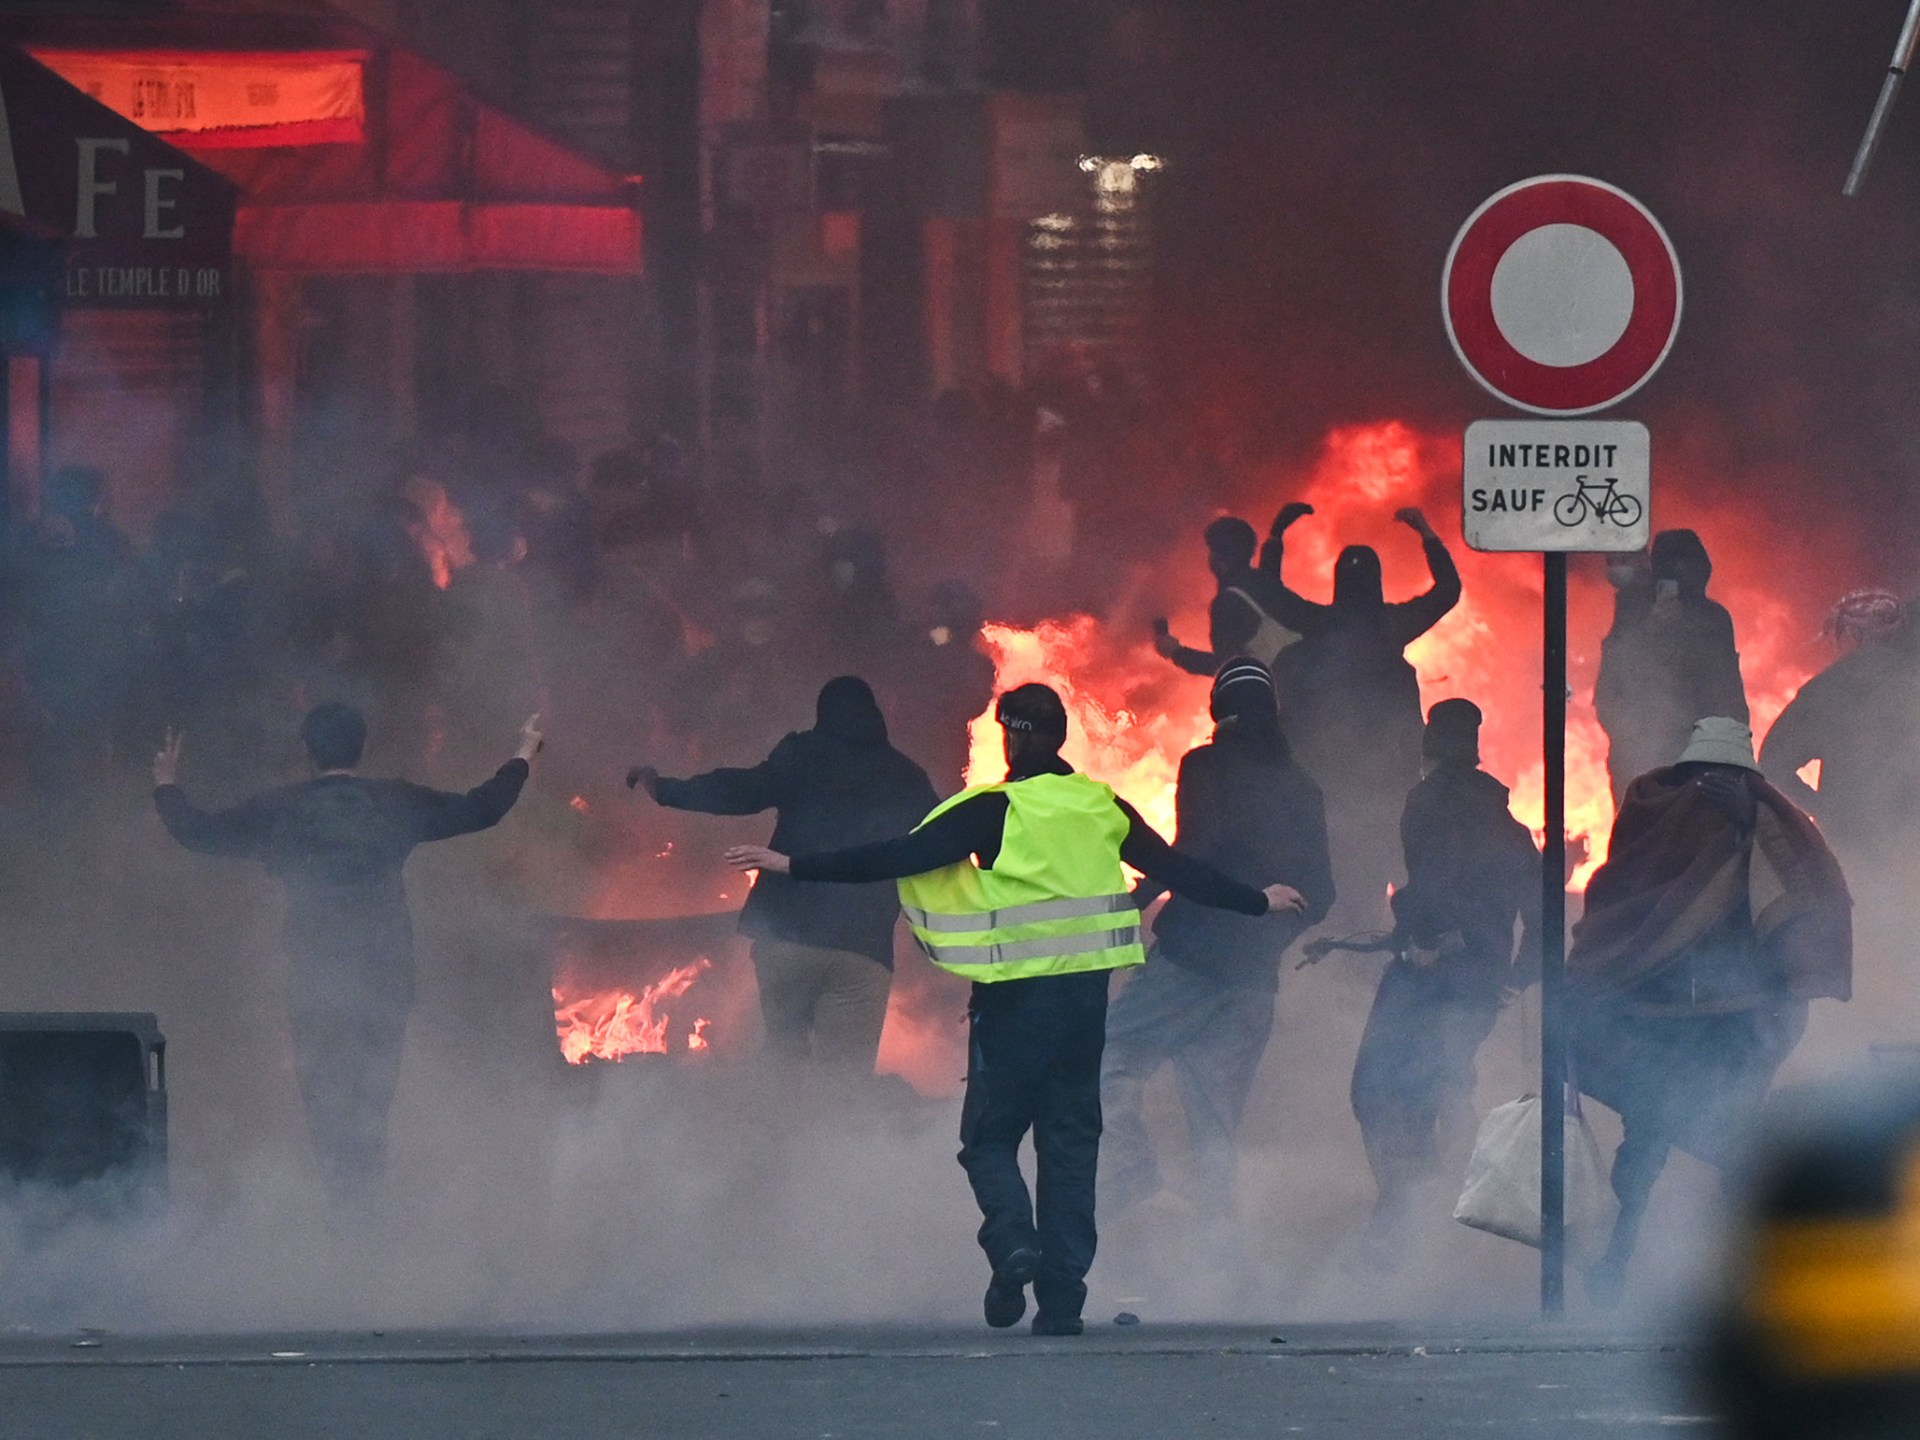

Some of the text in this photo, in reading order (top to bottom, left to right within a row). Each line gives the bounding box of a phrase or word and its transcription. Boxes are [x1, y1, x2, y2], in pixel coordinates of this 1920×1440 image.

[66, 268, 89, 297] LE
[97, 267, 170, 297] TEMPLE
[1488, 444, 1618, 468] INTERDIT
[1472, 489, 1545, 512] SAUF
